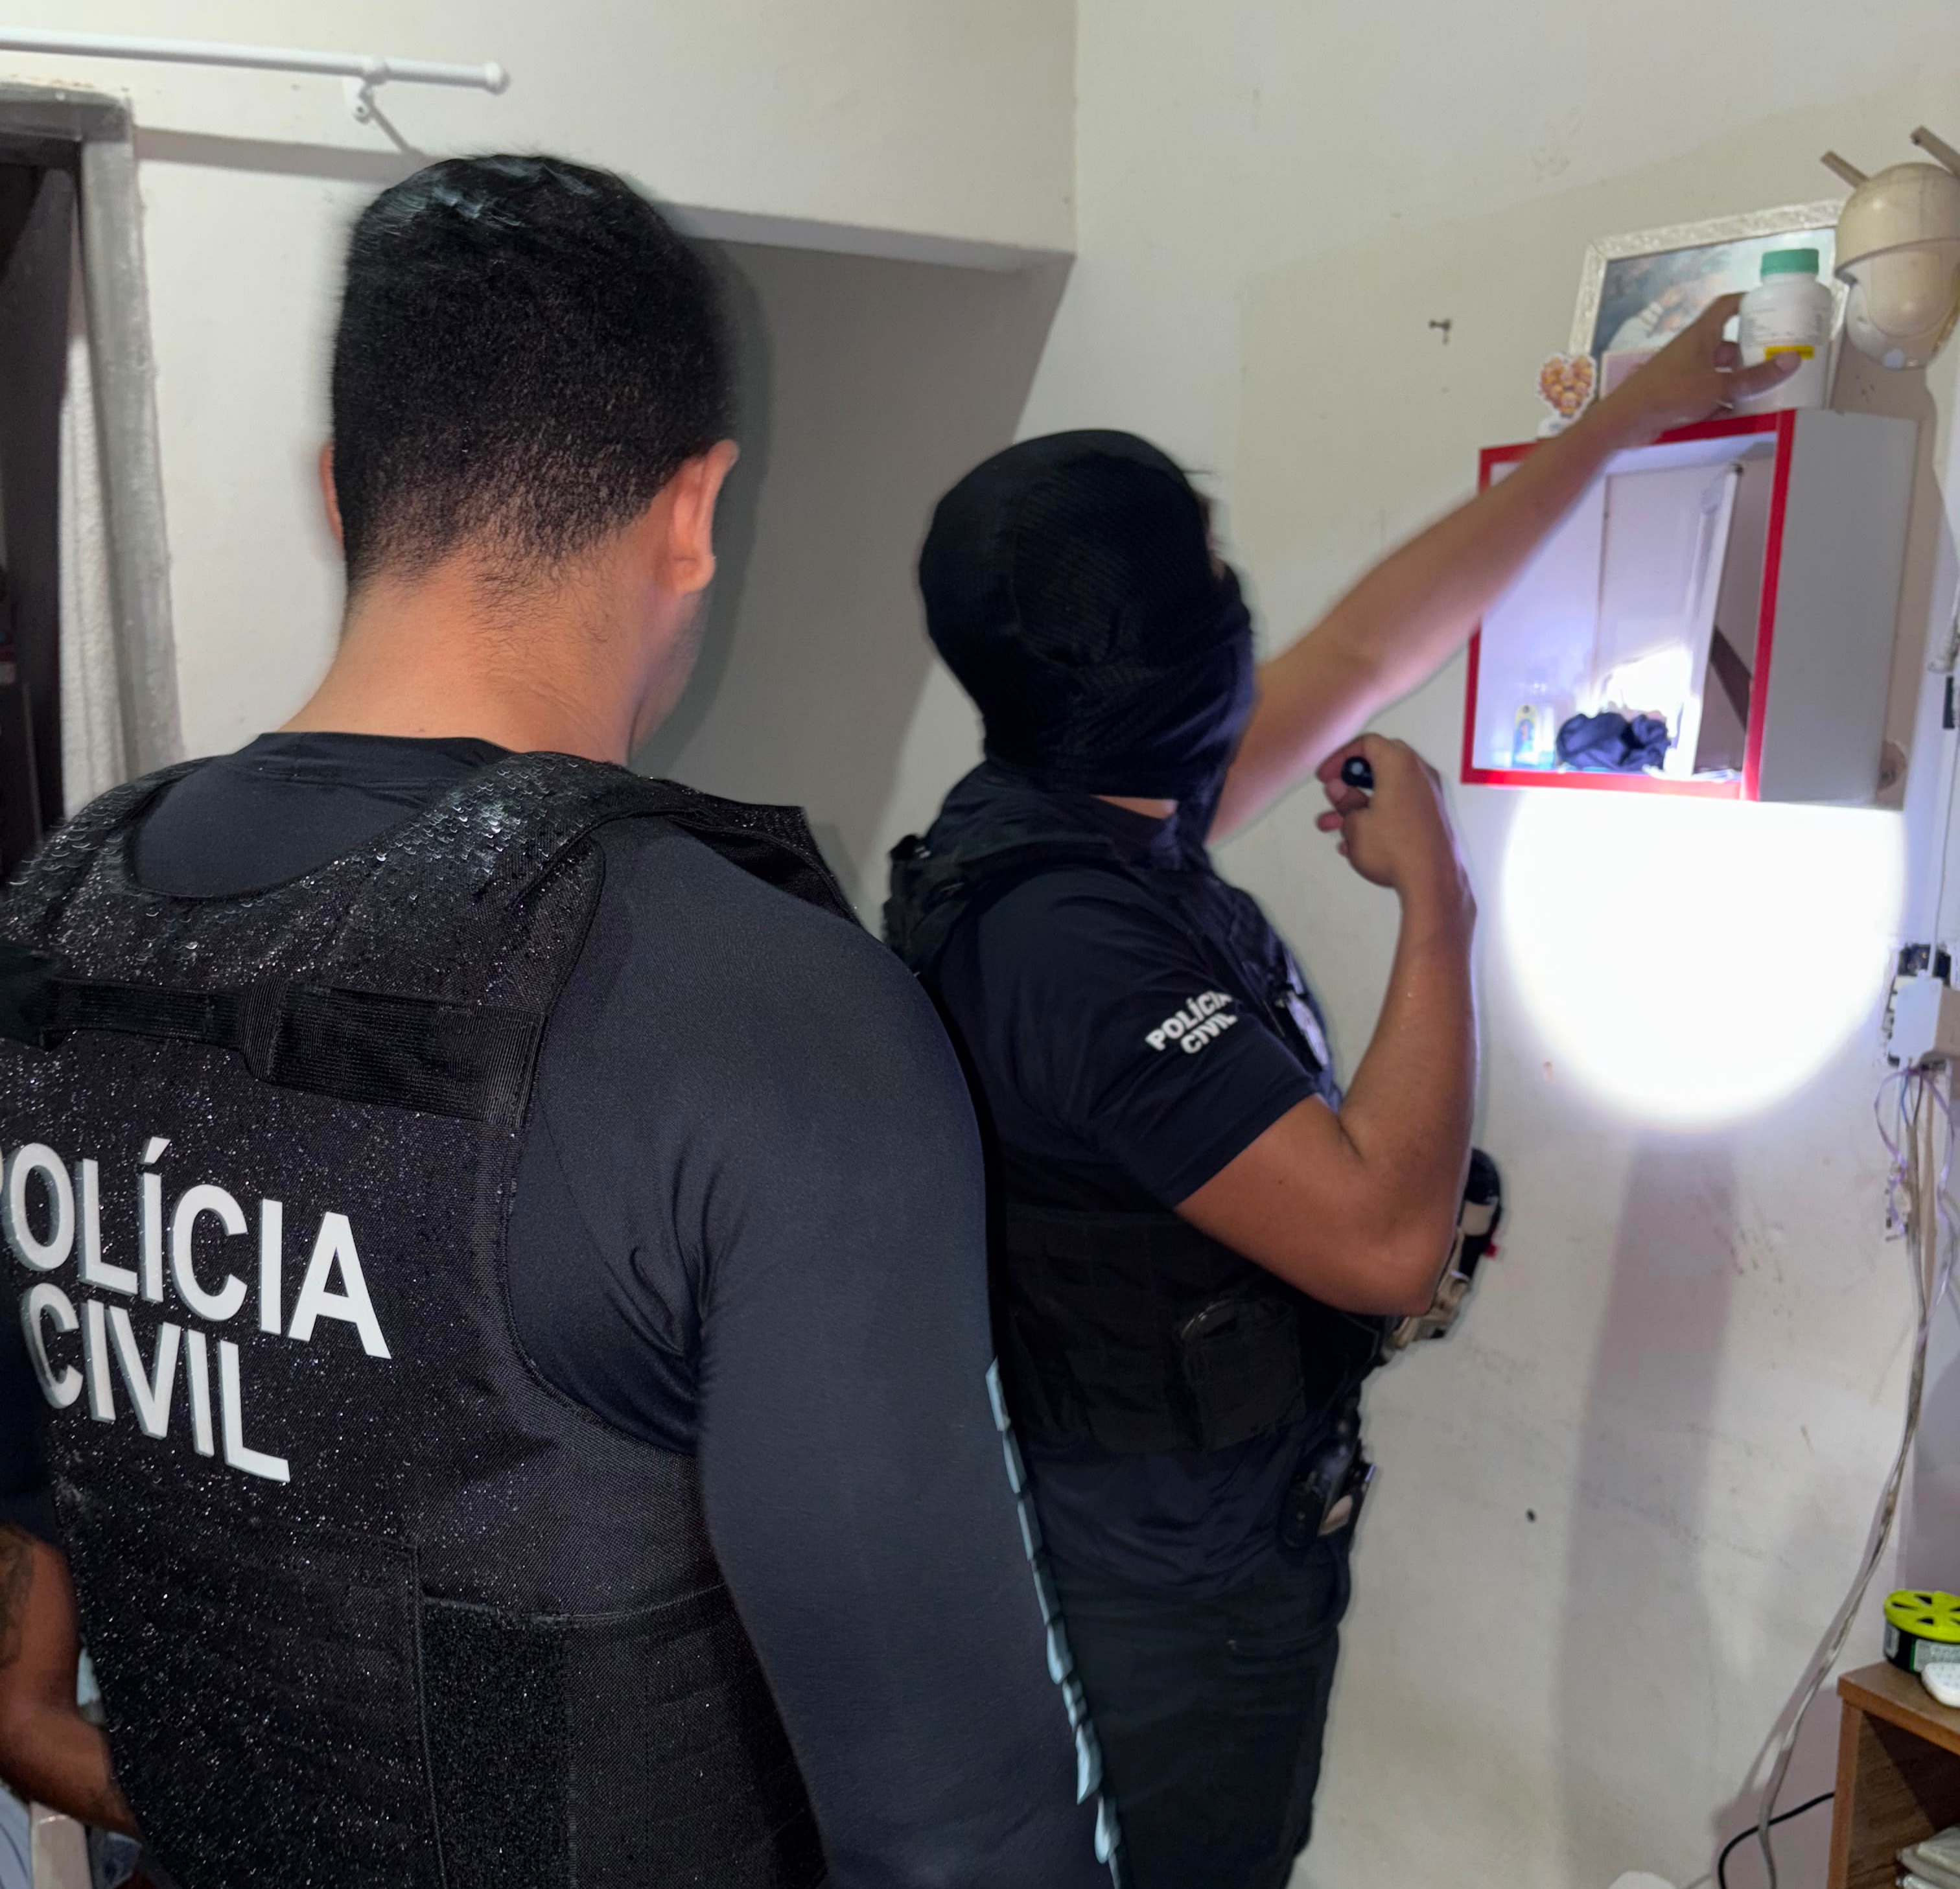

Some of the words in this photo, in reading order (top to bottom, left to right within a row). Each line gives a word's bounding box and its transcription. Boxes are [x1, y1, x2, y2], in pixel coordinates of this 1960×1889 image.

[1145, 990, 1233, 1050] POLÍCIA
[1180, 1013, 1237, 1054] CIVIL
[0, 1137, 391, 1360] OLÍCIA
[21, 1282, 291, 1483] CIVIL
